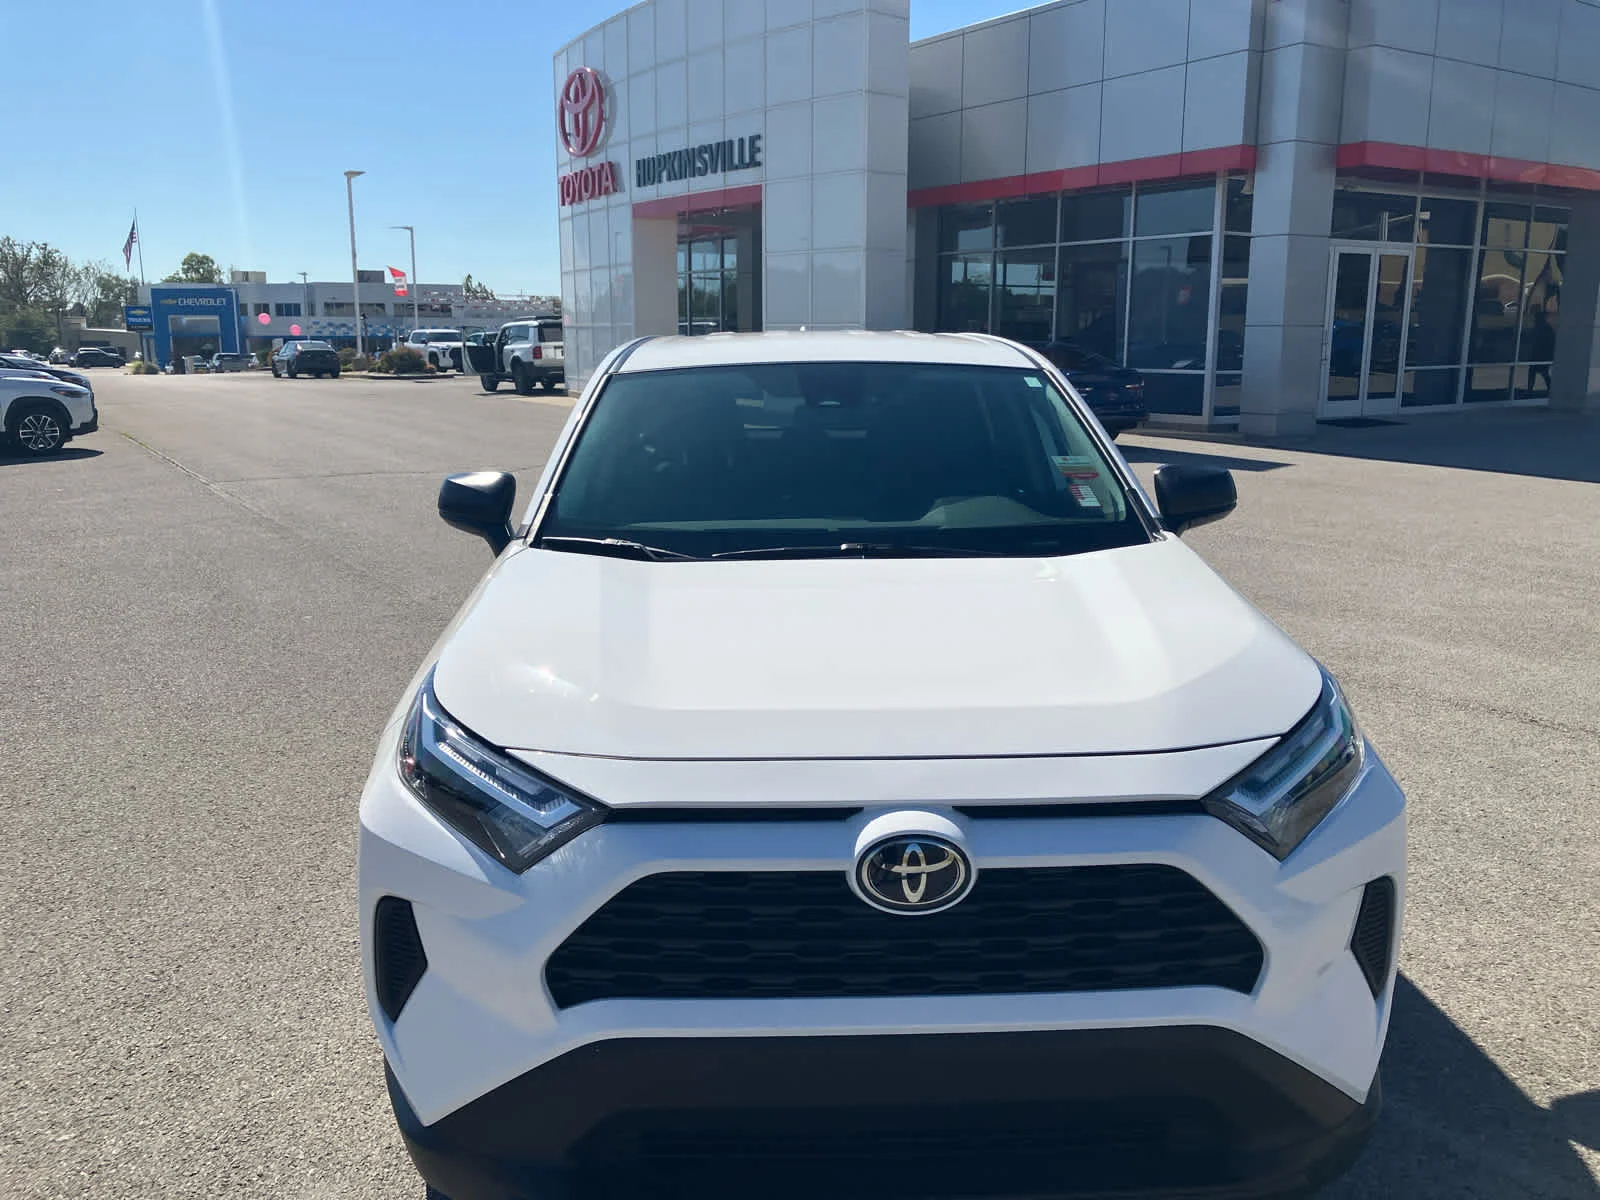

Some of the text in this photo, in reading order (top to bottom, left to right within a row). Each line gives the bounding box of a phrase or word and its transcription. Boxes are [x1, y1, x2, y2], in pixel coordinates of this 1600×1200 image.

[636, 134, 762, 187] HOPKINSVILLE
[559, 161, 617, 206] TOYOTA
[177, 297, 227, 306] CHEVROLET
